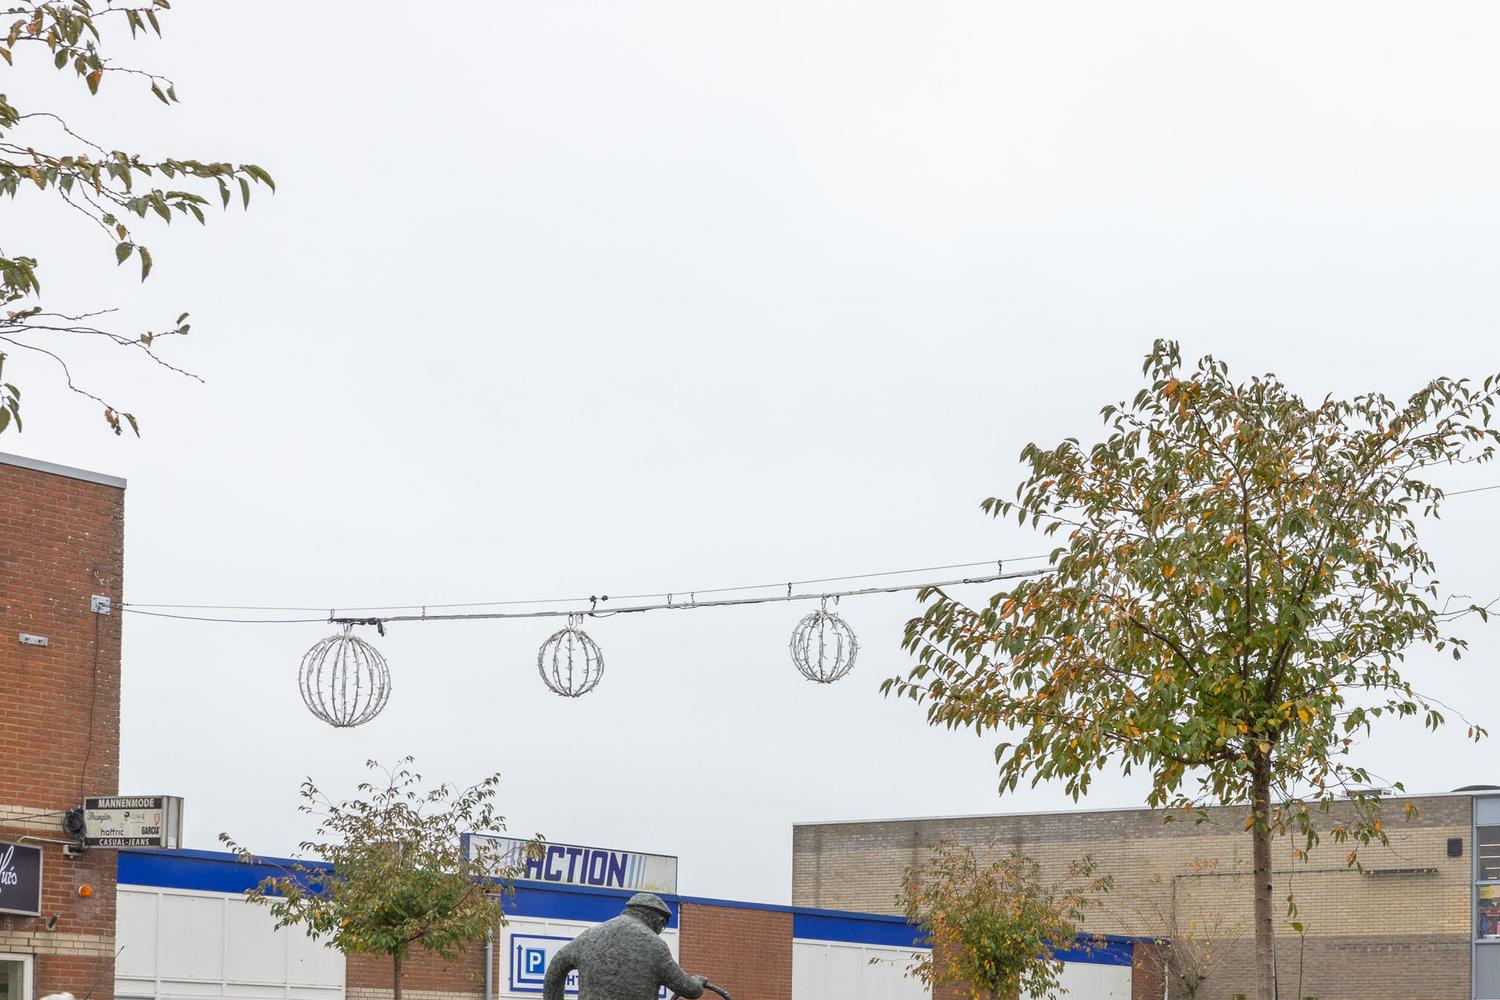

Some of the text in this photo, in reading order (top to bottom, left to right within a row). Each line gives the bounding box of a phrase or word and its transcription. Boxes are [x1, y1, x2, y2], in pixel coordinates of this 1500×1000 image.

[97, 798, 155, 809] MANNENMODE
[141, 825, 161, 835] GARCIA
[98, 838, 150, 847] CASUAL-JEANS
[523, 844, 629, 888] ACTION
[529, 951, 543, 973] P
